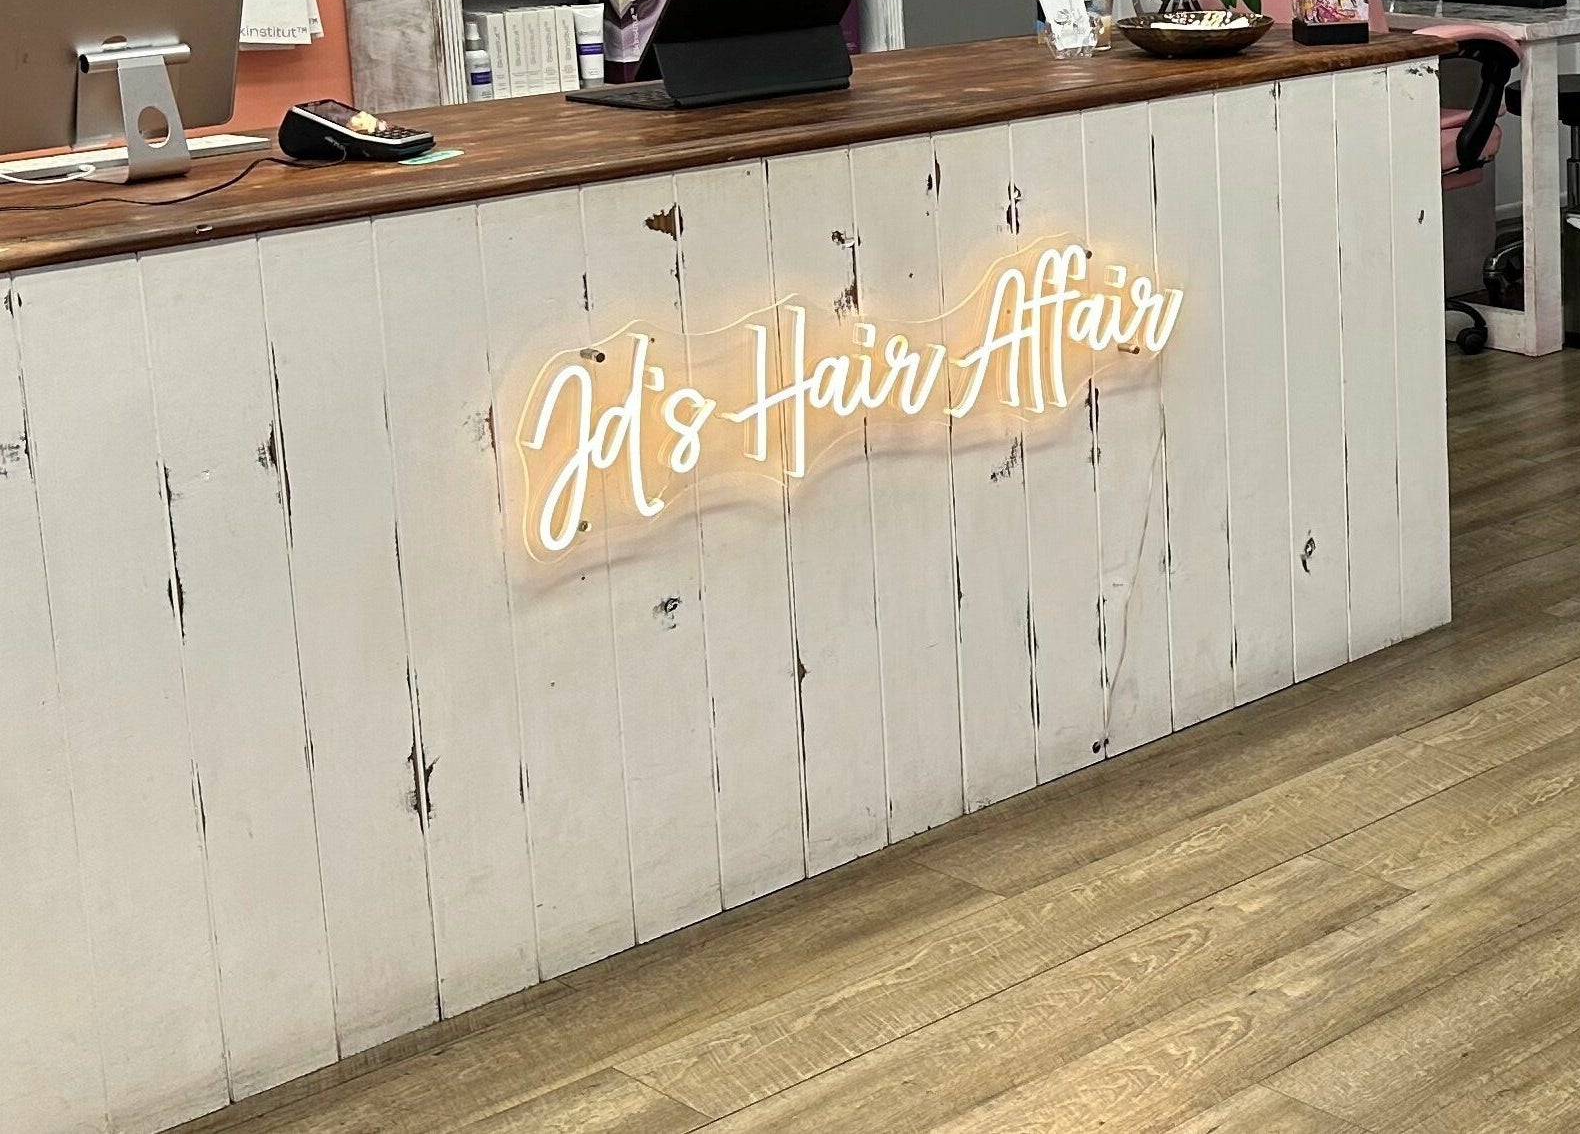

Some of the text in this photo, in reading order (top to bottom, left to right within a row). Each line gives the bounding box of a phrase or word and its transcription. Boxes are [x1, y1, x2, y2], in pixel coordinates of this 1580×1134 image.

[525, 244, 1186, 552] Jd's Hair Affair
